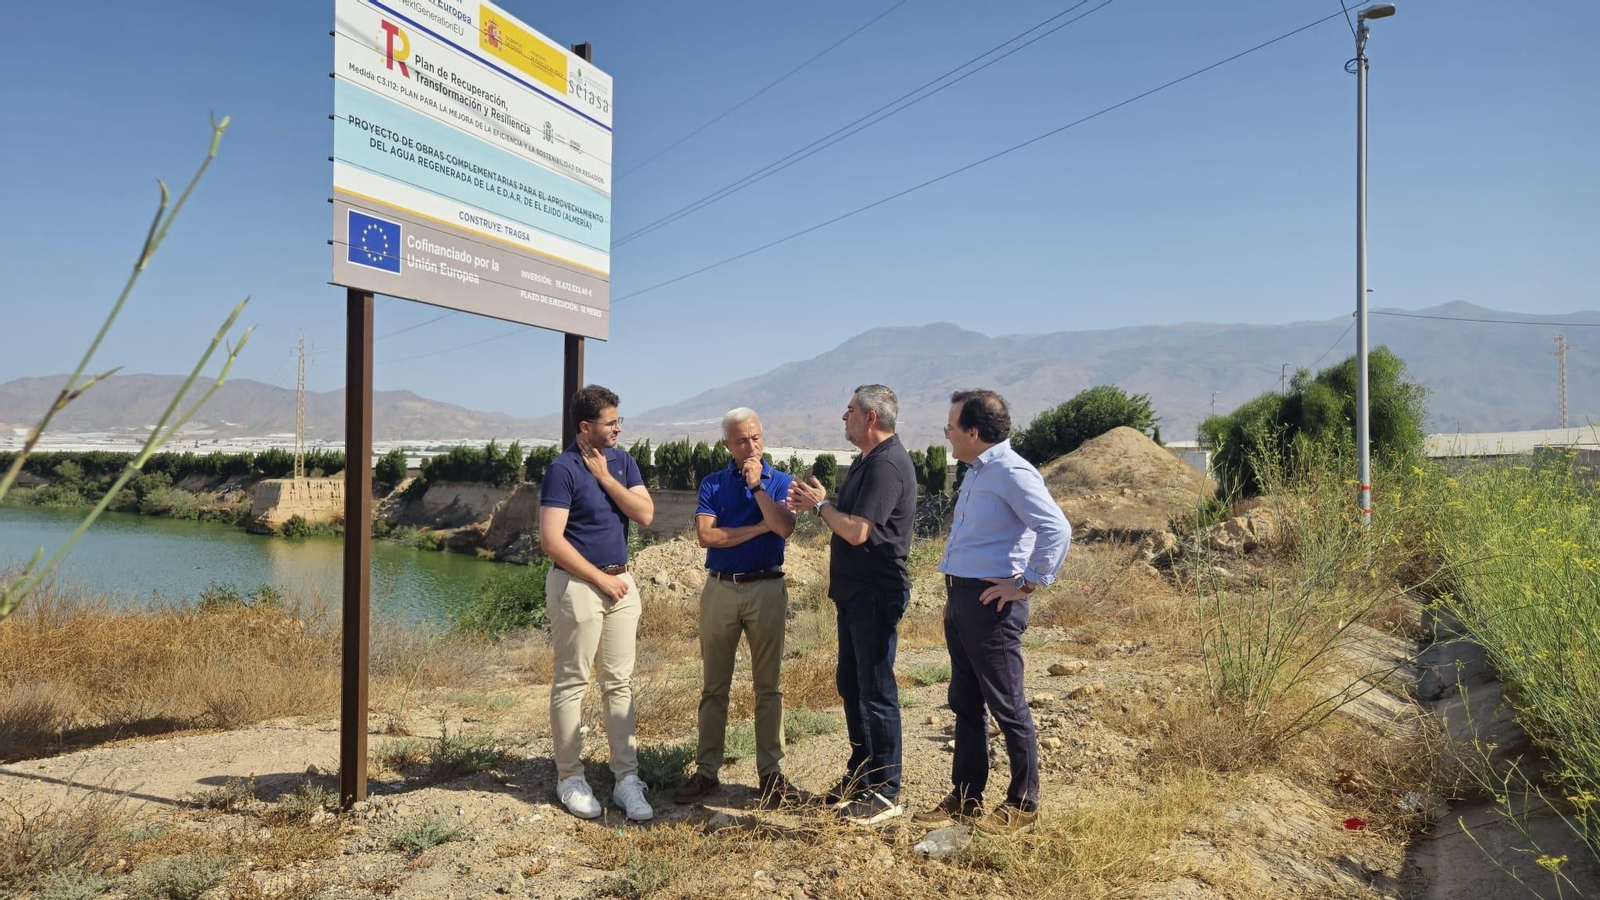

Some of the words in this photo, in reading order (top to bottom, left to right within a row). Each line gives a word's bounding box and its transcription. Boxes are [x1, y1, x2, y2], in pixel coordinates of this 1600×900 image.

[415, 54, 435, 74] Plan
[437, 67, 449, 80] de
[451, 73, 509, 112] Recuperación,
[415, 70, 482, 112] Transformación
[484, 106, 489, 116] y
[491, 107, 531, 135] Resiliencia
[568, 79, 609, 113] seiasa
[348, 62, 375, 81] Medida
[400, 86, 419, 100] PLAN
[420, 95, 438, 109] PARA
[439, 104, 448, 114] LA
[449, 108, 474, 125] MEJORA
[475, 120, 484, 130] DE
[484, 123, 492, 133] LA
[493, 128, 523, 147] EFICIENCIA
[528, 144, 536, 154] LA
[536, 147, 575, 171] SOSTENIBILIDAD
[348, 115, 400, 143] PROYECTO
[402, 136, 414, 149] DE
[415, 142, 445, 160] OBRAS
[446, 154, 518, 190] COMPLEMENTARIAS
[519, 183, 537, 197] PARA
[538, 191, 547, 201] EL
[547, 193, 604, 223] APROVECHAMIENTO
[369, 138, 388, 153] DEL
[390, 146, 415, 163] AGUA
[417, 156, 473, 187] REGENERADA
[474, 177, 484, 189] DE
[485, 184, 496, 196] LA
[497, 187, 523, 204] E.D.A.R.
[524, 196, 533, 208] DE
[534, 201, 543, 211] EL
[543, 204, 561, 218] EJIDO
[459, 211, 503, 233] CONSTRUYE:
[505, 226, 531, 241] TRAGSA
[407, 235, 472, 264] Cofinanciado
[474, 256, 490, 269] por
[491, 258, 500, 272] la
[407, 254, 437, 274] Unión
[440, 263, 479, 284] Europea
[520, 290, 540, 302] PLAZO
[541, 295, 549, 304] DE
[587, 307, 602, 318] MESES
